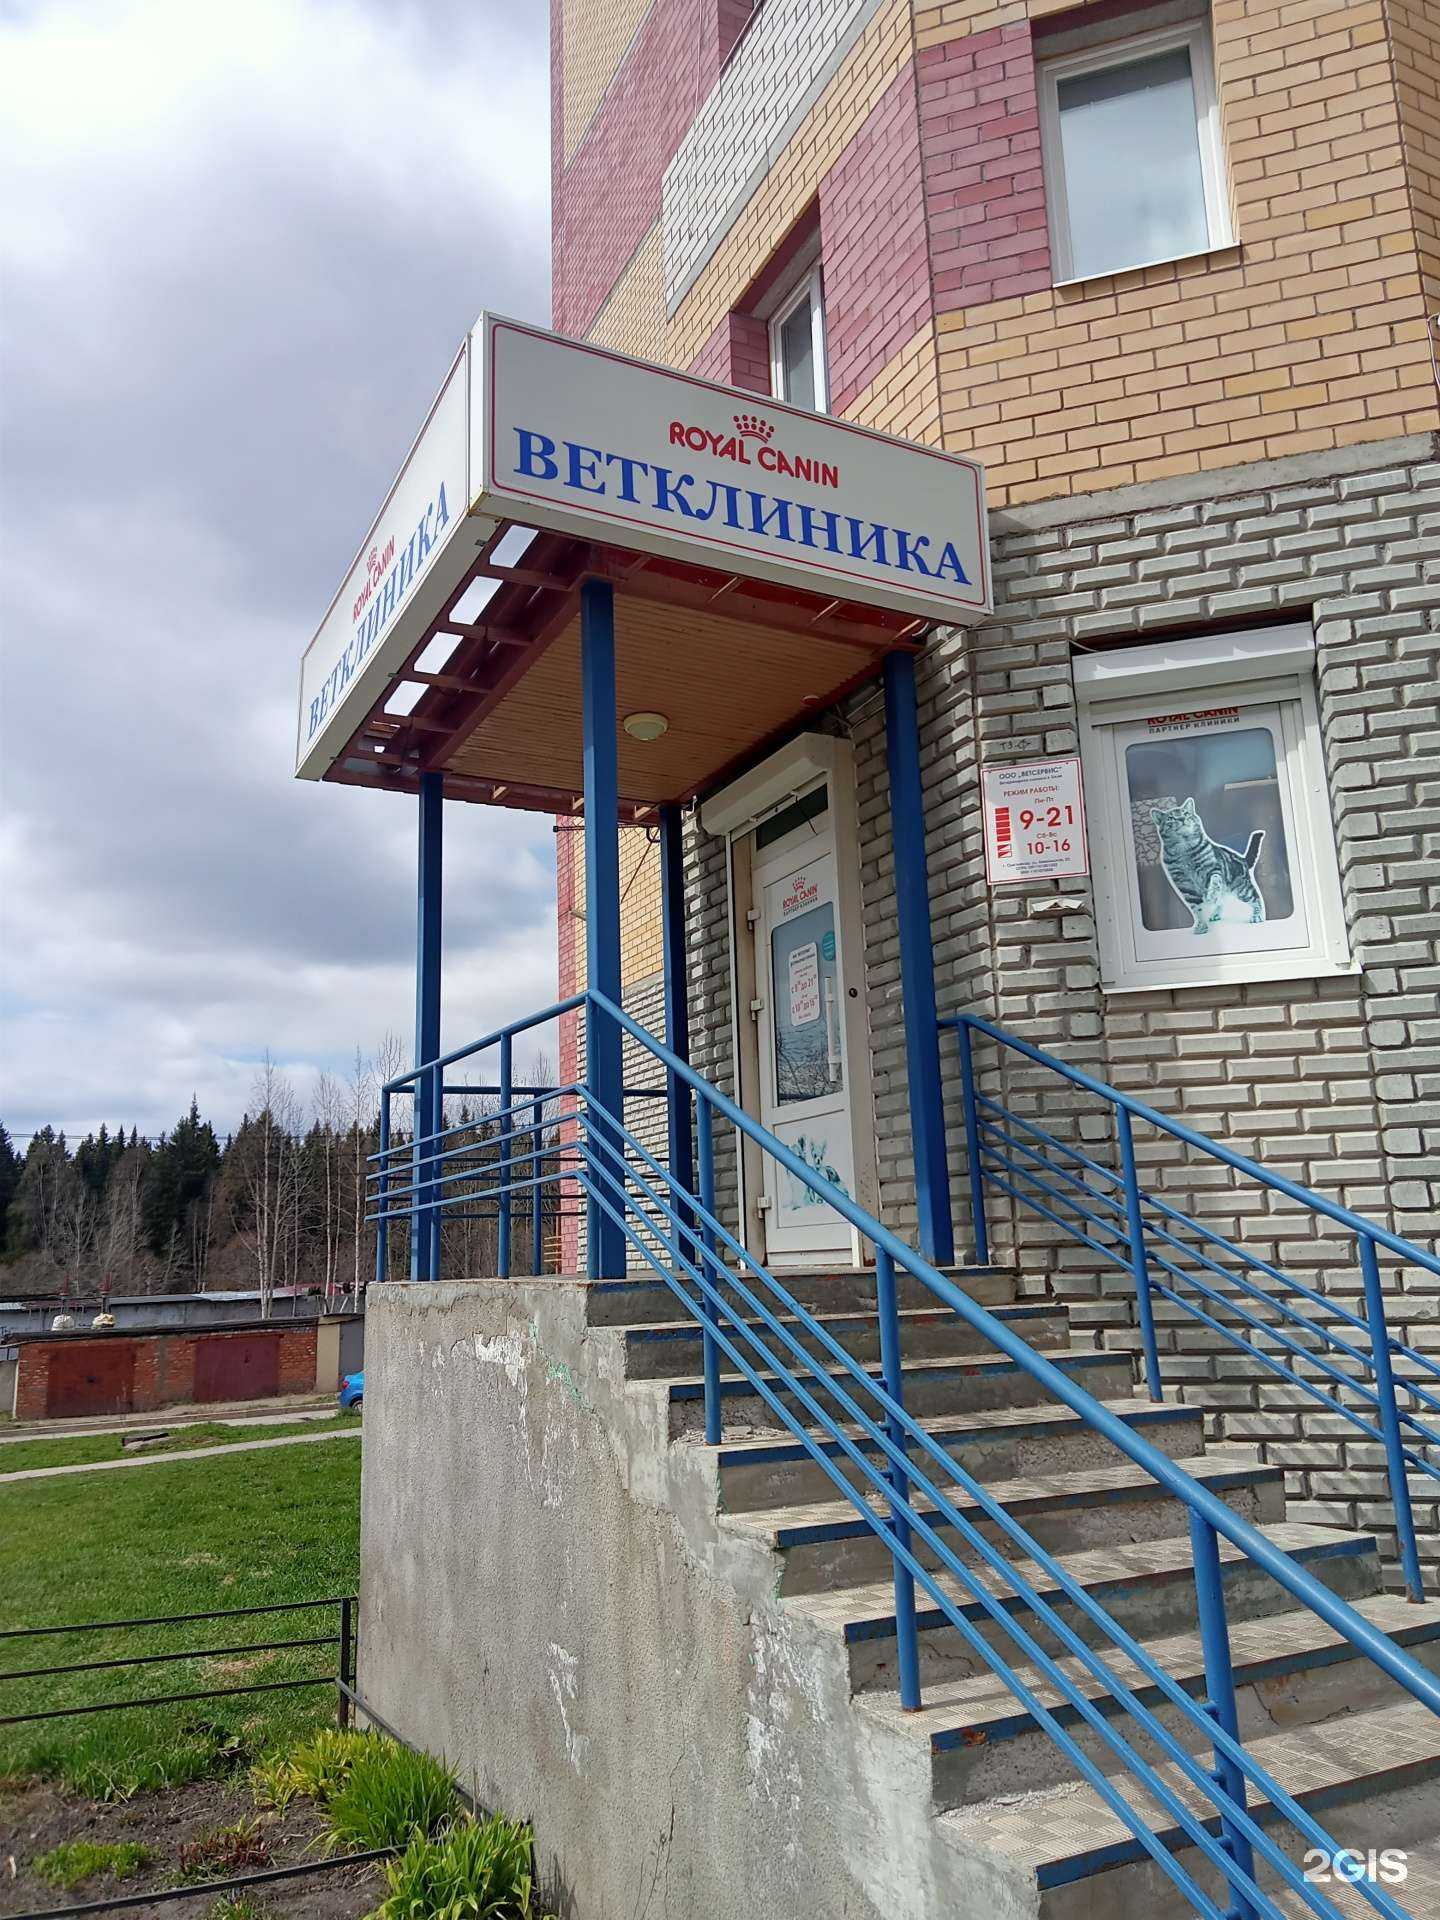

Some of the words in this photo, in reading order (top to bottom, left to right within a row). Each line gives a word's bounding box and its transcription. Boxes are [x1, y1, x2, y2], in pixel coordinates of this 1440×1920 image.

[669, 421, 751, 466] ROYAL
[758, 446, 839, 489] CANIN
[513, 427, 972, 586] ВЕТКЛИНИКА
[352, 577, 373, 624] ROYAL
[371, 535, 395, 588] CANIN
[308, 481, 449, 742] ВЕТКЛИНИКА
[1149, 723, 1190, 734] ПАРТНЕР
[1193, 717, 1240, 729] КЛИНИКИ
[998, 771, 1017, 780] ООО
[1003, 788, 1028, 798] РЕЖИМ
[1019, 805, 1073, 830] 9-21
[1027, 839, 1071, 855] 10-16
